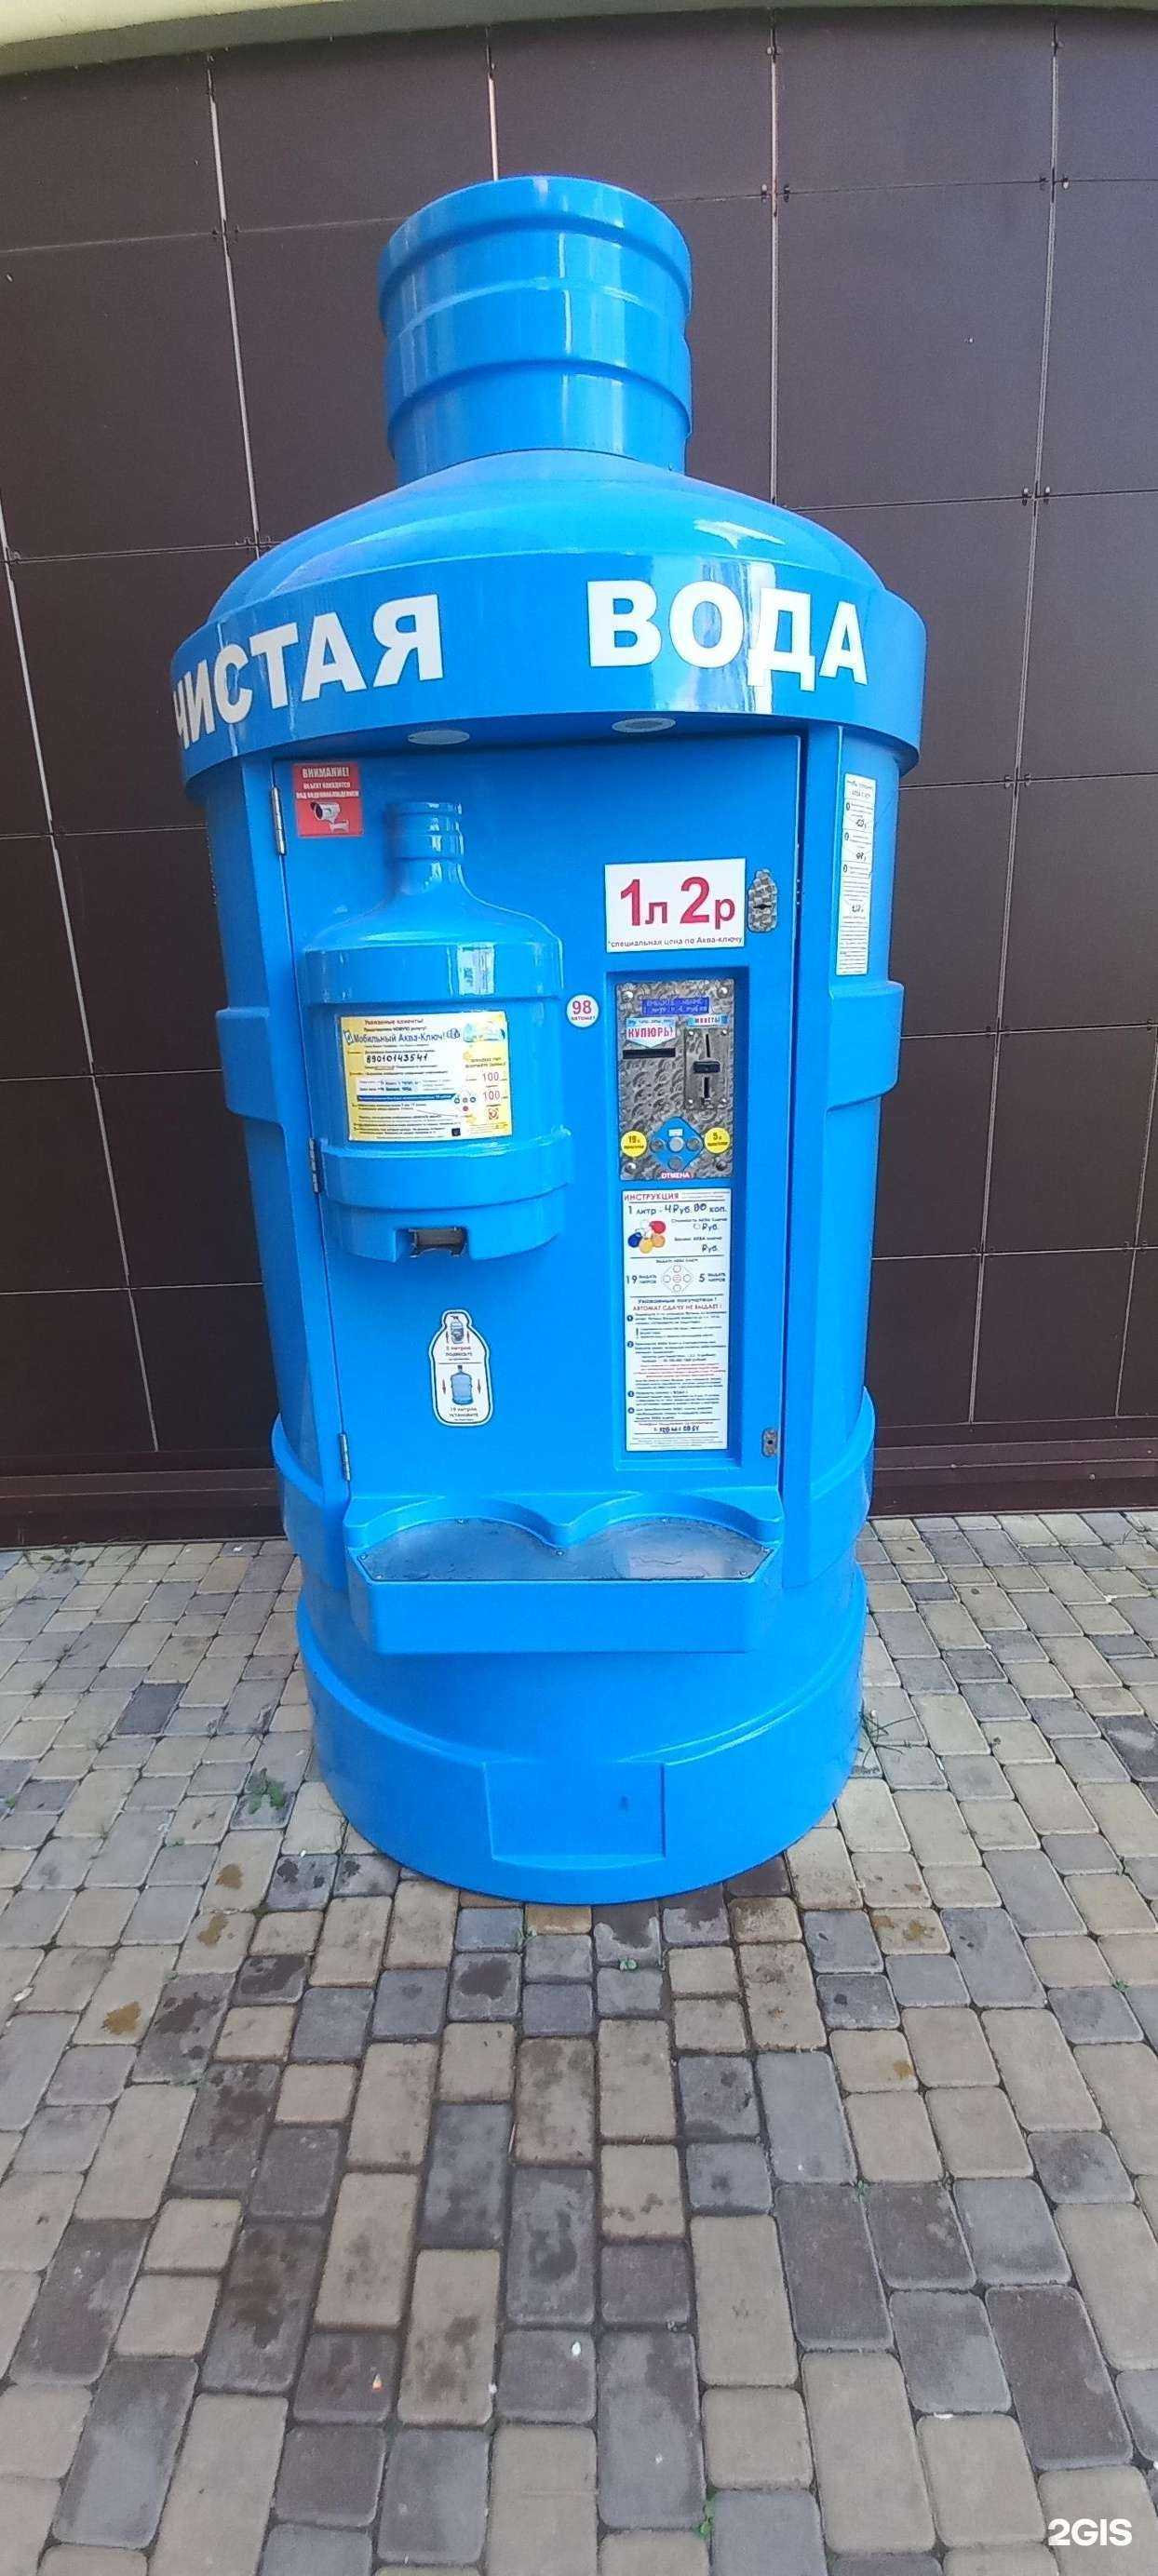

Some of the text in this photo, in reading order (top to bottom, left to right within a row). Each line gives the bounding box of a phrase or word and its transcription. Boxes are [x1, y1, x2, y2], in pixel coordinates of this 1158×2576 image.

[172, 580, 868, 750] ЧИСТАЯ ВОДА
[302, 767, 350, 779] ВНИМАНИЕ!
[620, 876, 736, 931] 1л 2р
[664, 938, 683, 946] цена
[572, 1000, 592, 1015] 98
[354, 1034, 397, 1043] Мобильный
[624, 1192, 680, 1201] ИНСТРУКЦИЯ
[698, 1273, 706, 1283] 5
